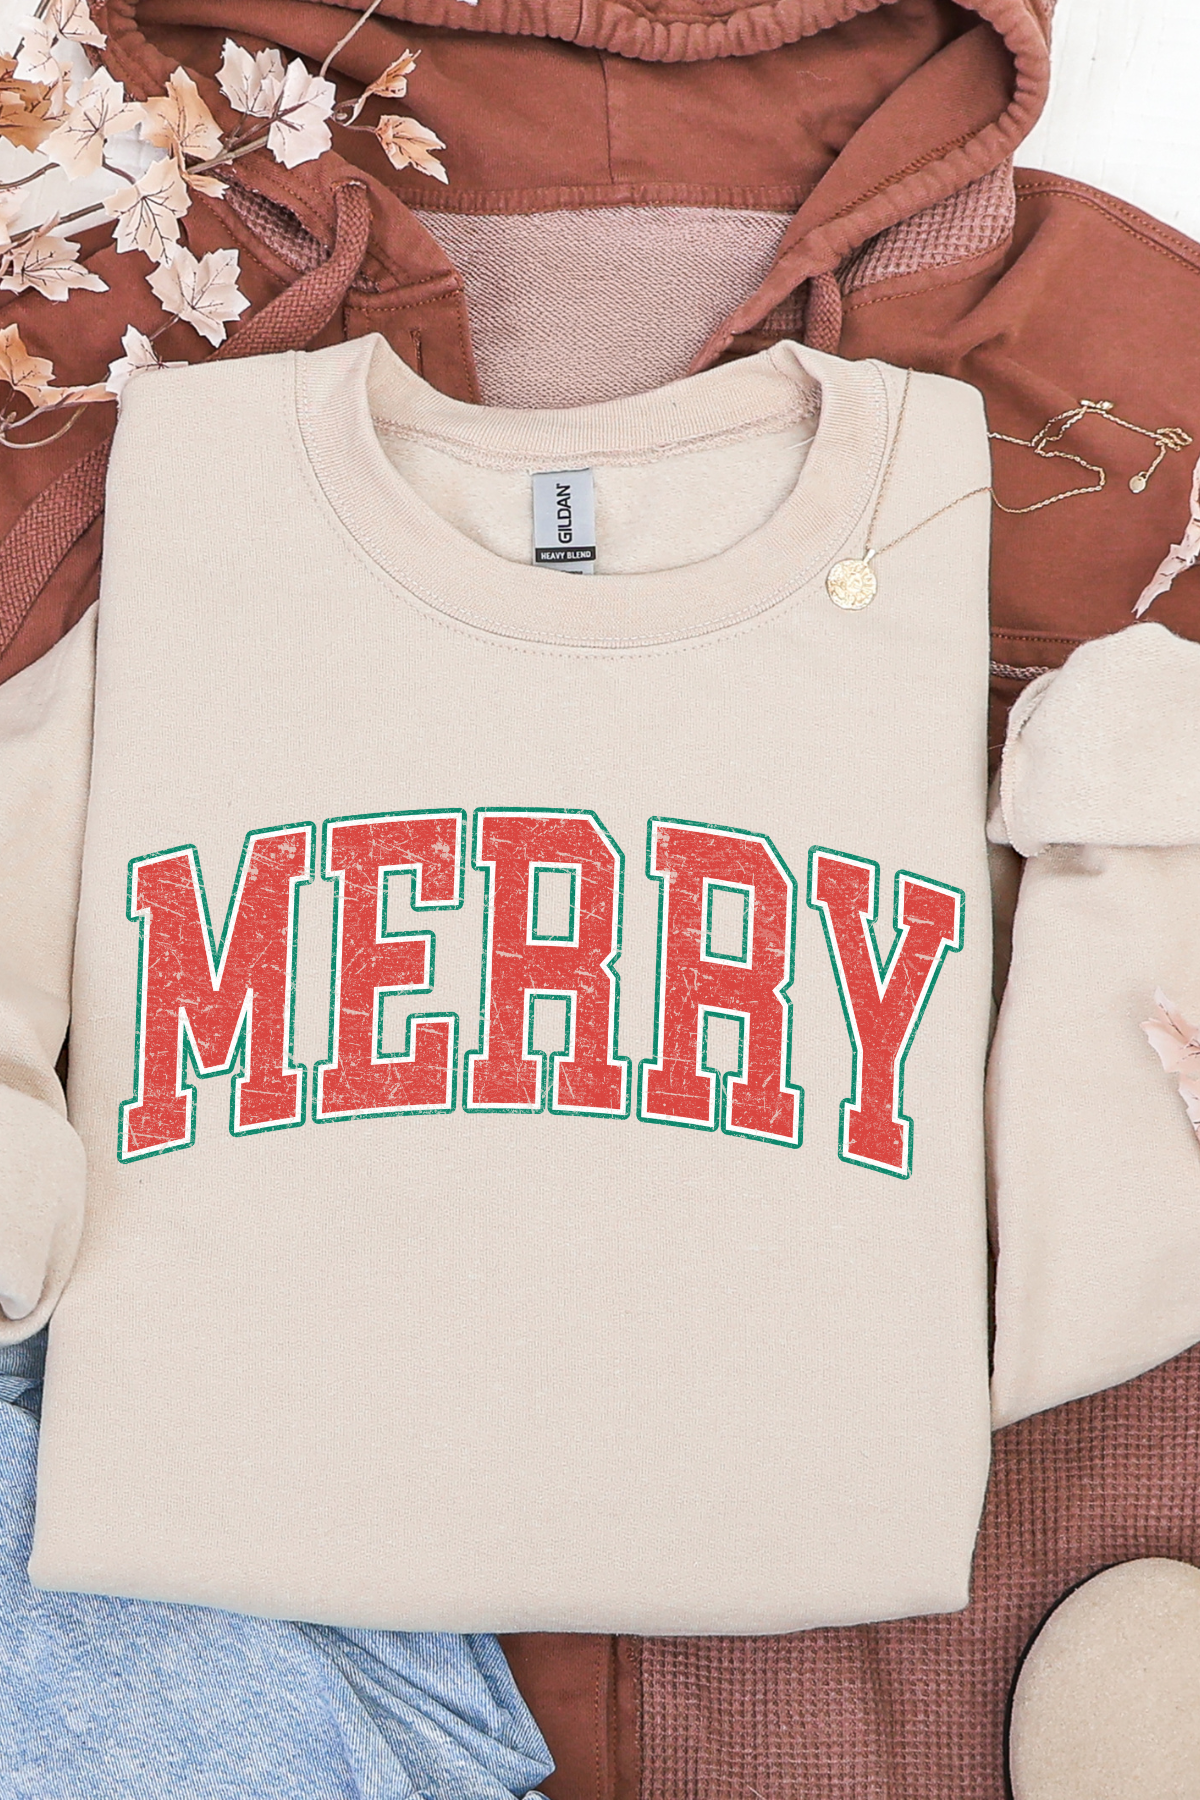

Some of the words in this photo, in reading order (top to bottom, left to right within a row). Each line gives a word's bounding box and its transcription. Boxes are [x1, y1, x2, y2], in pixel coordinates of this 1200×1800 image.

[556, 483, 573, 544] GILDAN
[541, 552, 565, 560] HEAVY
[567, 551, 591, 559] BLEND
[117, 807, 964, 1179] MERRY
